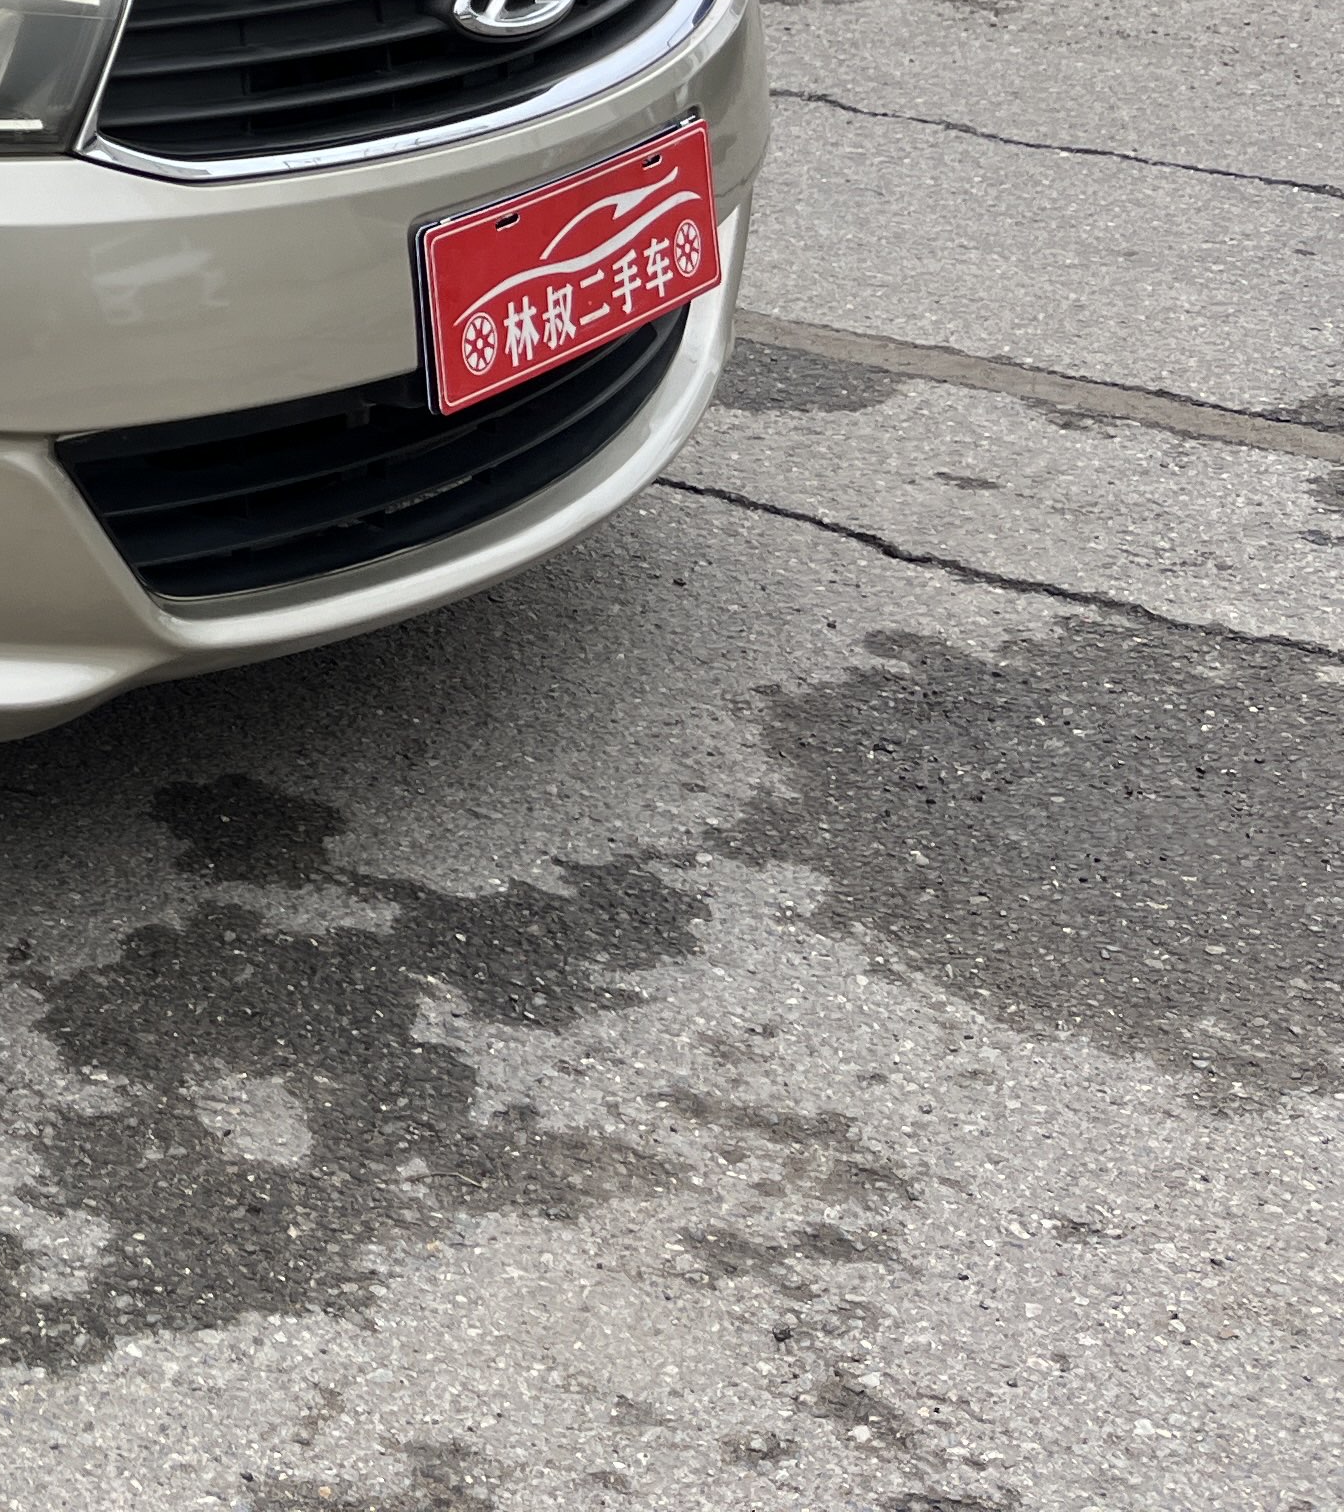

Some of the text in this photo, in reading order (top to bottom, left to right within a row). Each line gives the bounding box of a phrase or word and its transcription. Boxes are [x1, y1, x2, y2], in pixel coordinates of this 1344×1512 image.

[503, 237, 674, 367] 林叔二手车
